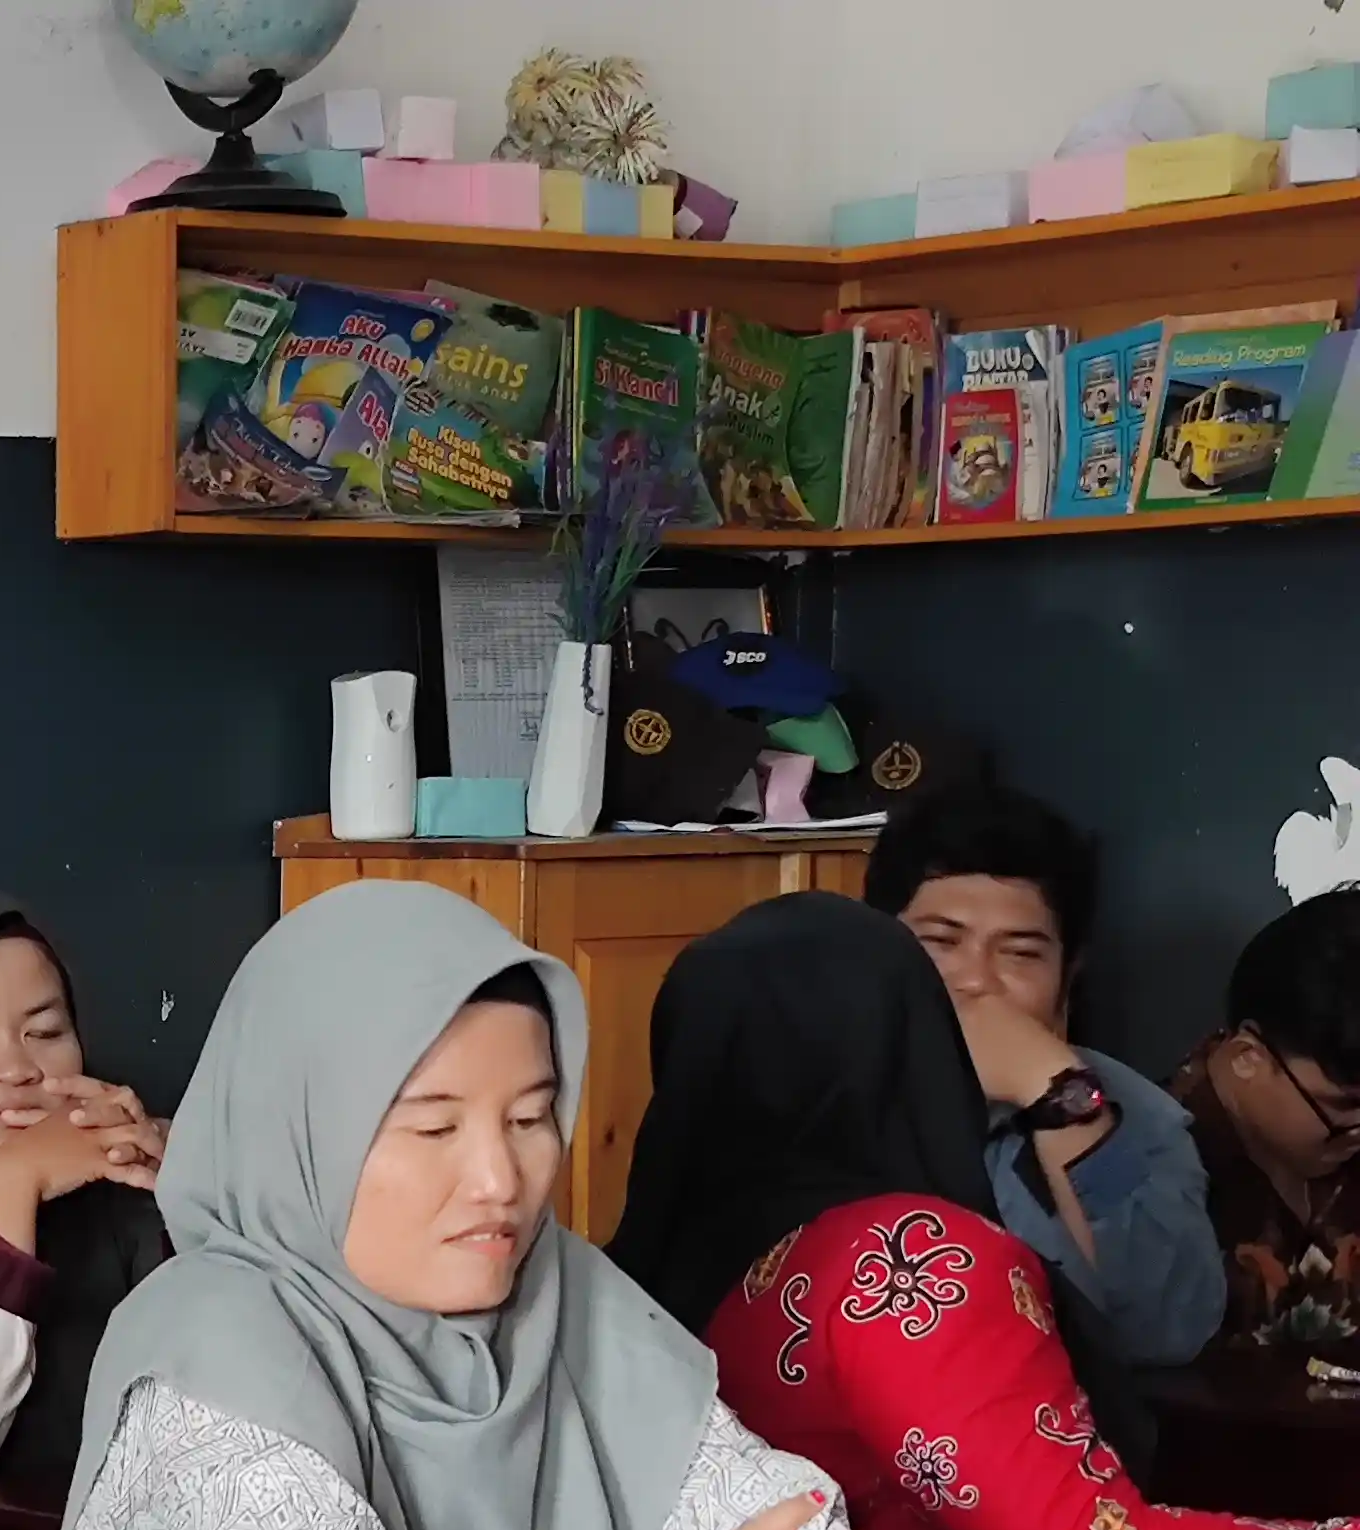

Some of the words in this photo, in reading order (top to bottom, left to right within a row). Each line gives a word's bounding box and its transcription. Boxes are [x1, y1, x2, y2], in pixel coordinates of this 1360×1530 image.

[282, 335, 354, 361] Hamba
[434, 344, 530, 389] sains
[1172, 345, 1234, 369] Reading
[1237, 343, 1307, 366] Program
[614, 362, 678, 407] Kancl
[707, 373, 764, 420] Anak
[407, 426, 445, 461] Rusa
[448, 450, 513, 488] dengan
[437, 425, 481, 460] Kisah
[407, 446, 509, 500] Sahabatnya
